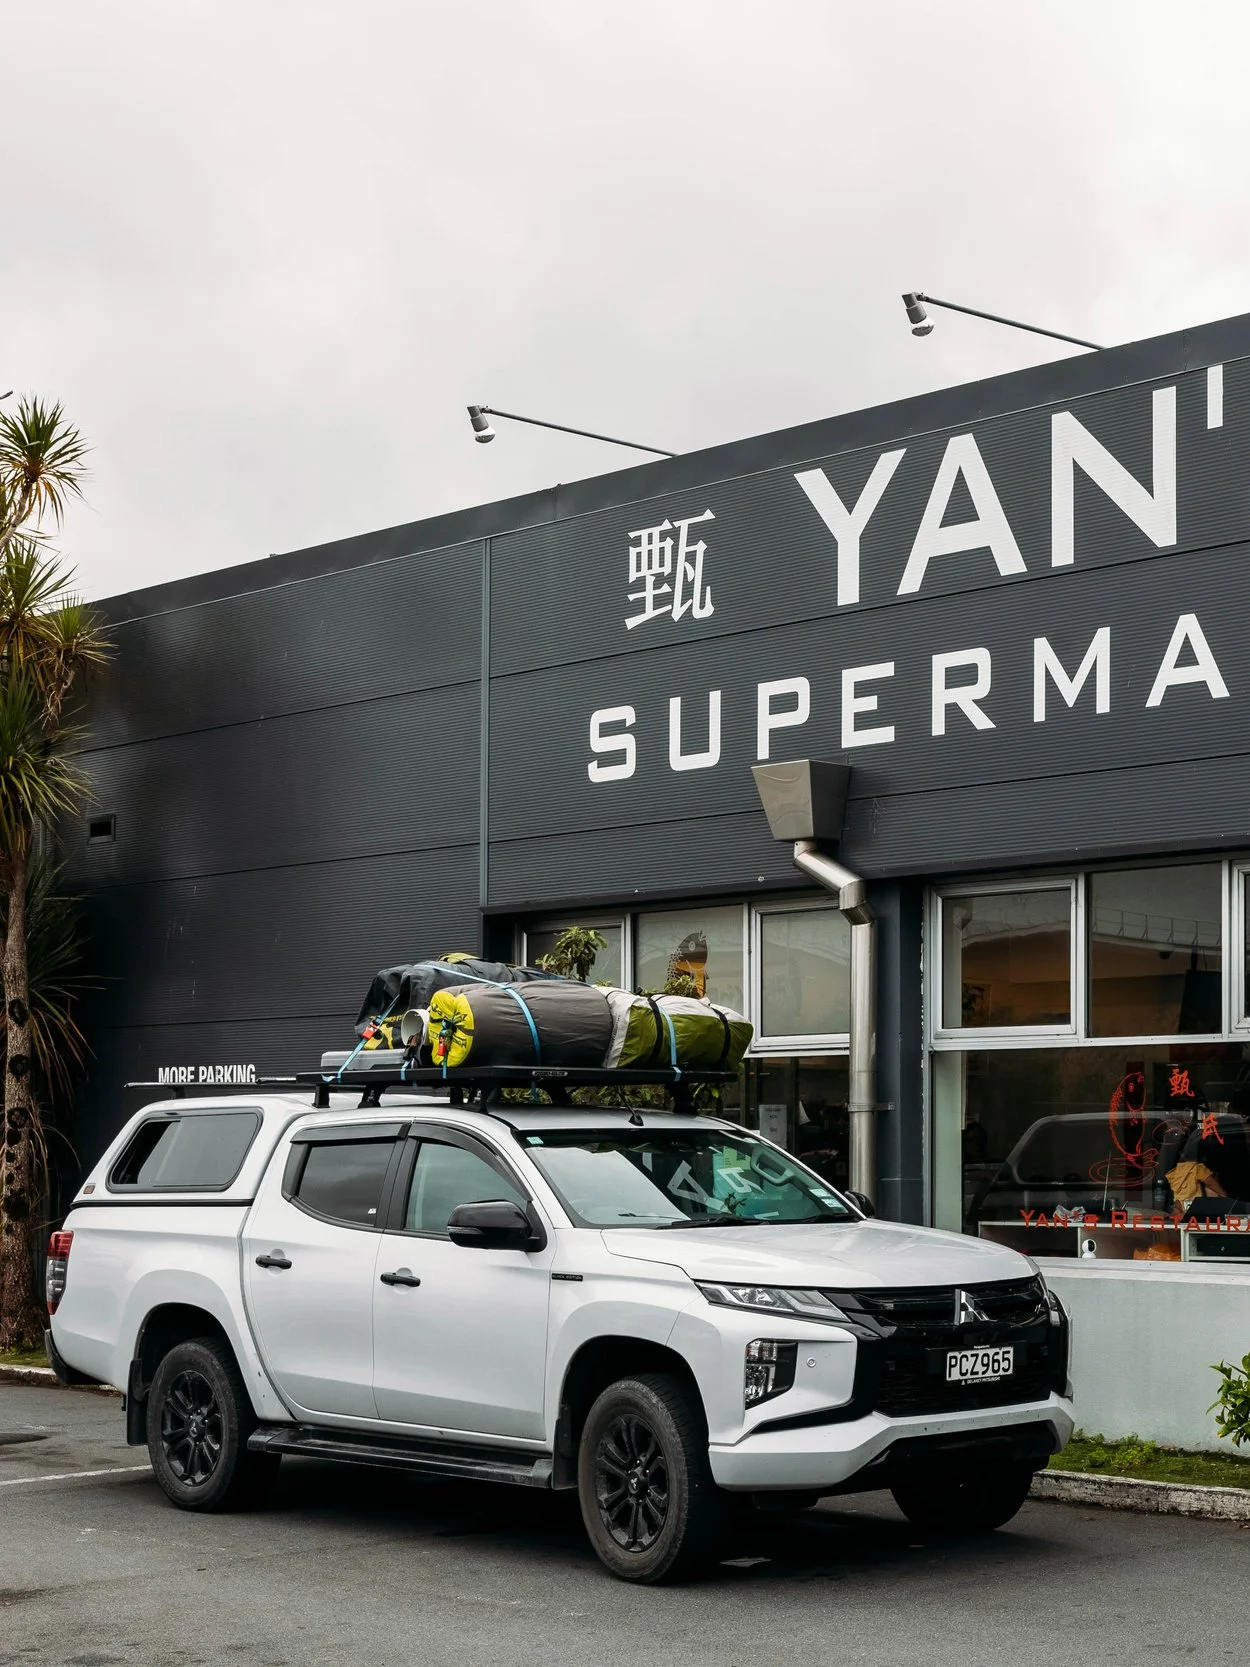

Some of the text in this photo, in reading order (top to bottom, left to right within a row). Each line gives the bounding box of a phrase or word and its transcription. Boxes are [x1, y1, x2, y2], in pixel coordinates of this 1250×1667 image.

[625, 509, 716, 630] 甄
[158, 1064, 256, 1083] MORE PARKING
[948, 1350, 1012, 1379] PCZ965
